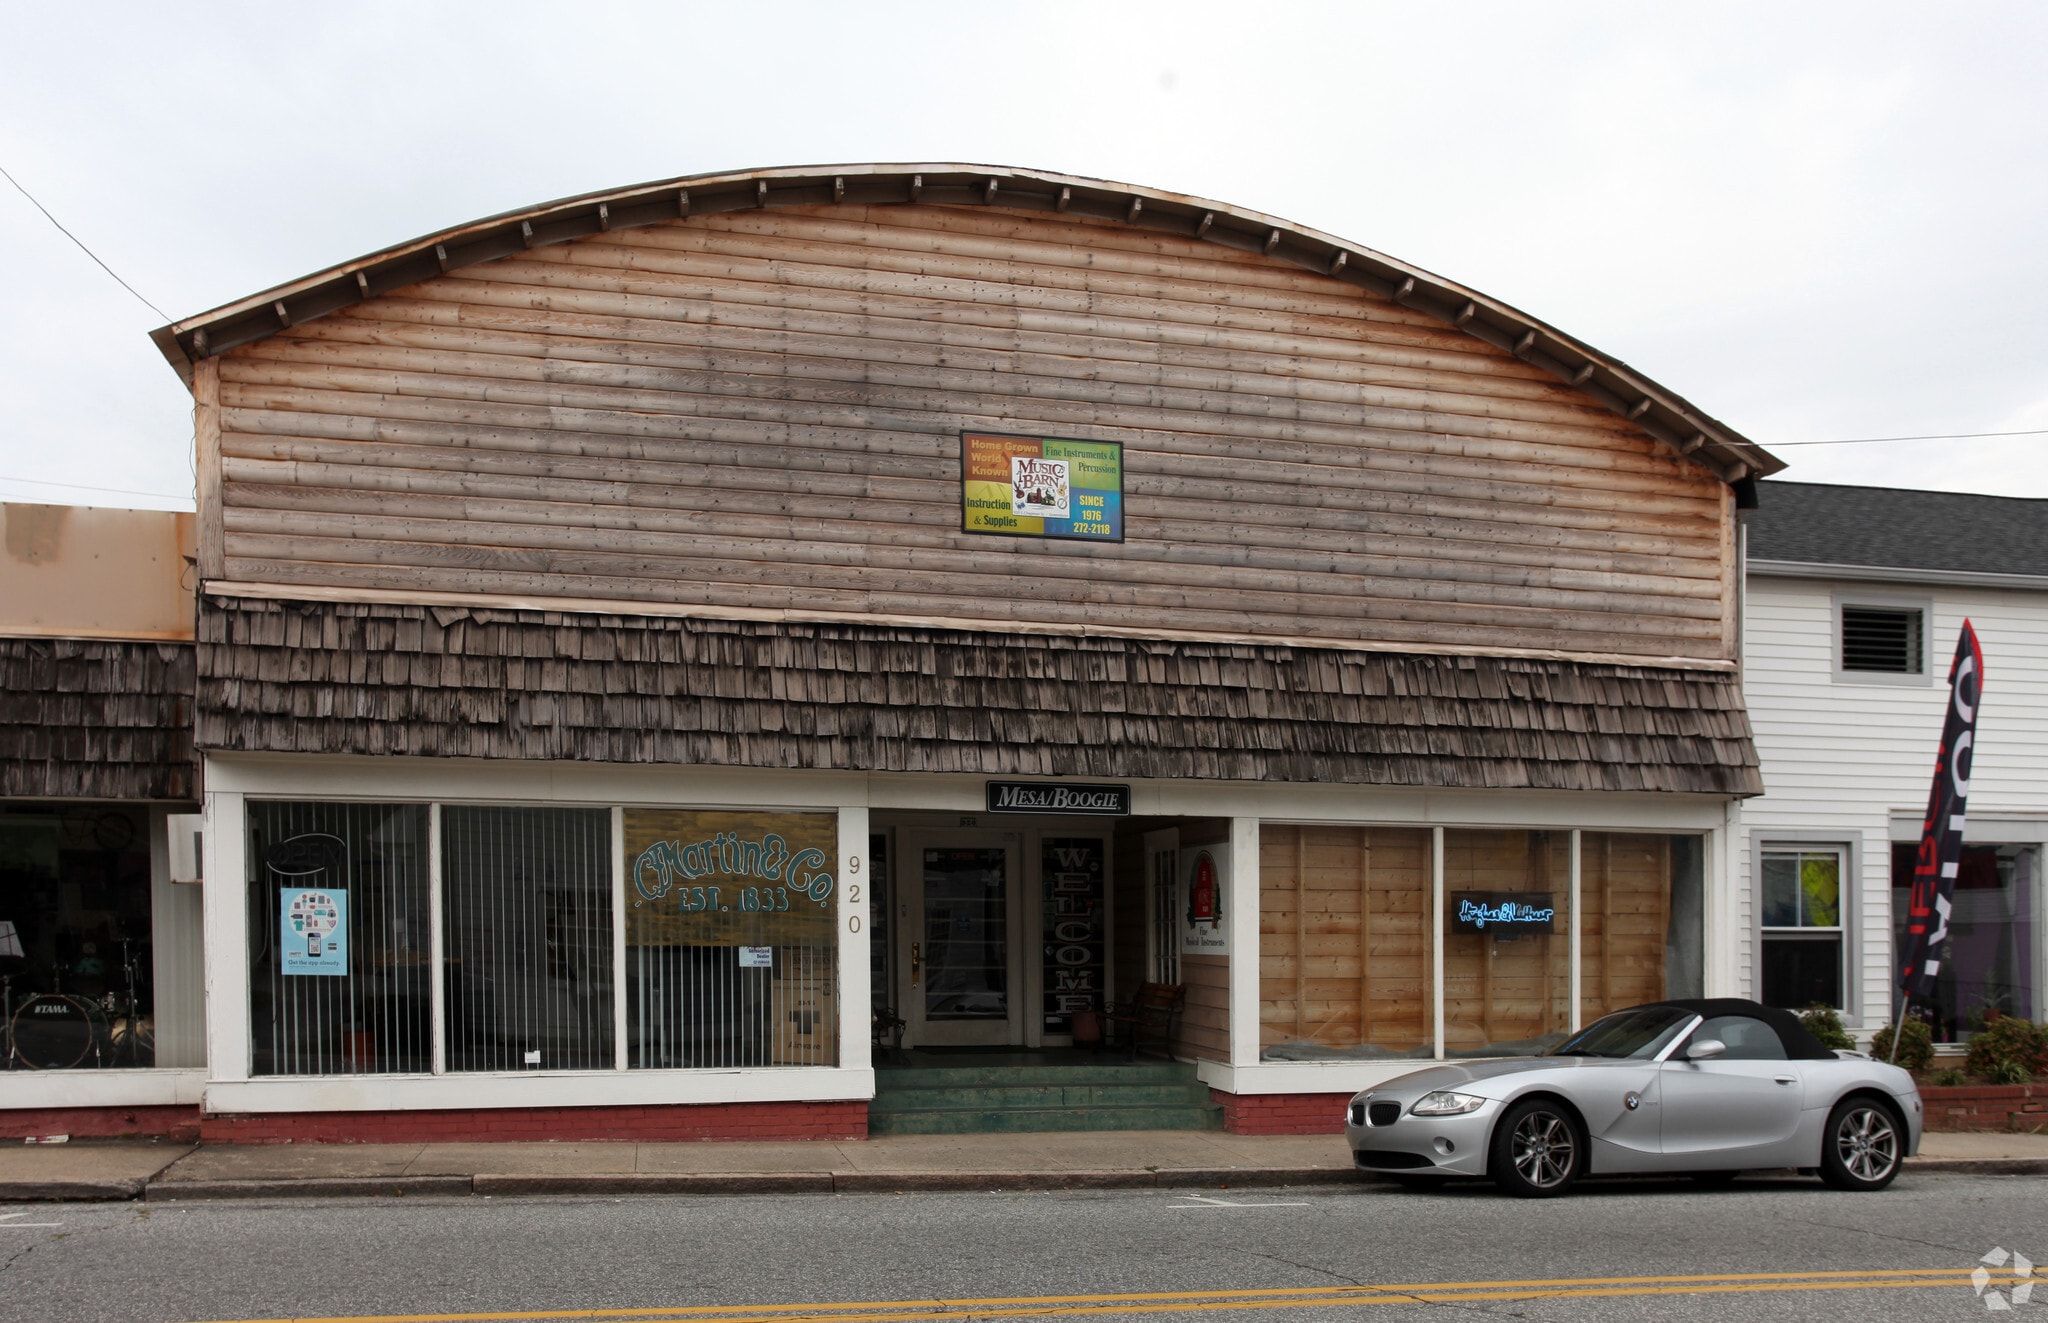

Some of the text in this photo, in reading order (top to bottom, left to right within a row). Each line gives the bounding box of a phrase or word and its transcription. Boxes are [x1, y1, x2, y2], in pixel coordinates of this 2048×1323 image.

[971, 439, 1039, 453] Home Grown
[971, 452, 1001, 463] World
[1045, 446, 1116, 461] Fine Instruments &
[971, 465, 1008, 477] Known
[1018, 458, 1065, 479] MUSIC
[1078, 461, 1117, 474] Percussion
[1022, 474, 1059, 489] BARN
[966, 498, 1011, 510] Instruction
[1079, 494, 1104, 507] SINCE
[974, 515, 1018, 528] & Supplies
[1082, 510, 1102, 521] 1976
[1073, 523, 1111, 535] 272-2118
[996, 786, 1119, 809] MESA/BOOGIE
[738, 886, 789, 911] 1833
[1054, 848, 1094, 1015] WELCOME
[41, 1005, 69, 1014] TAMA
